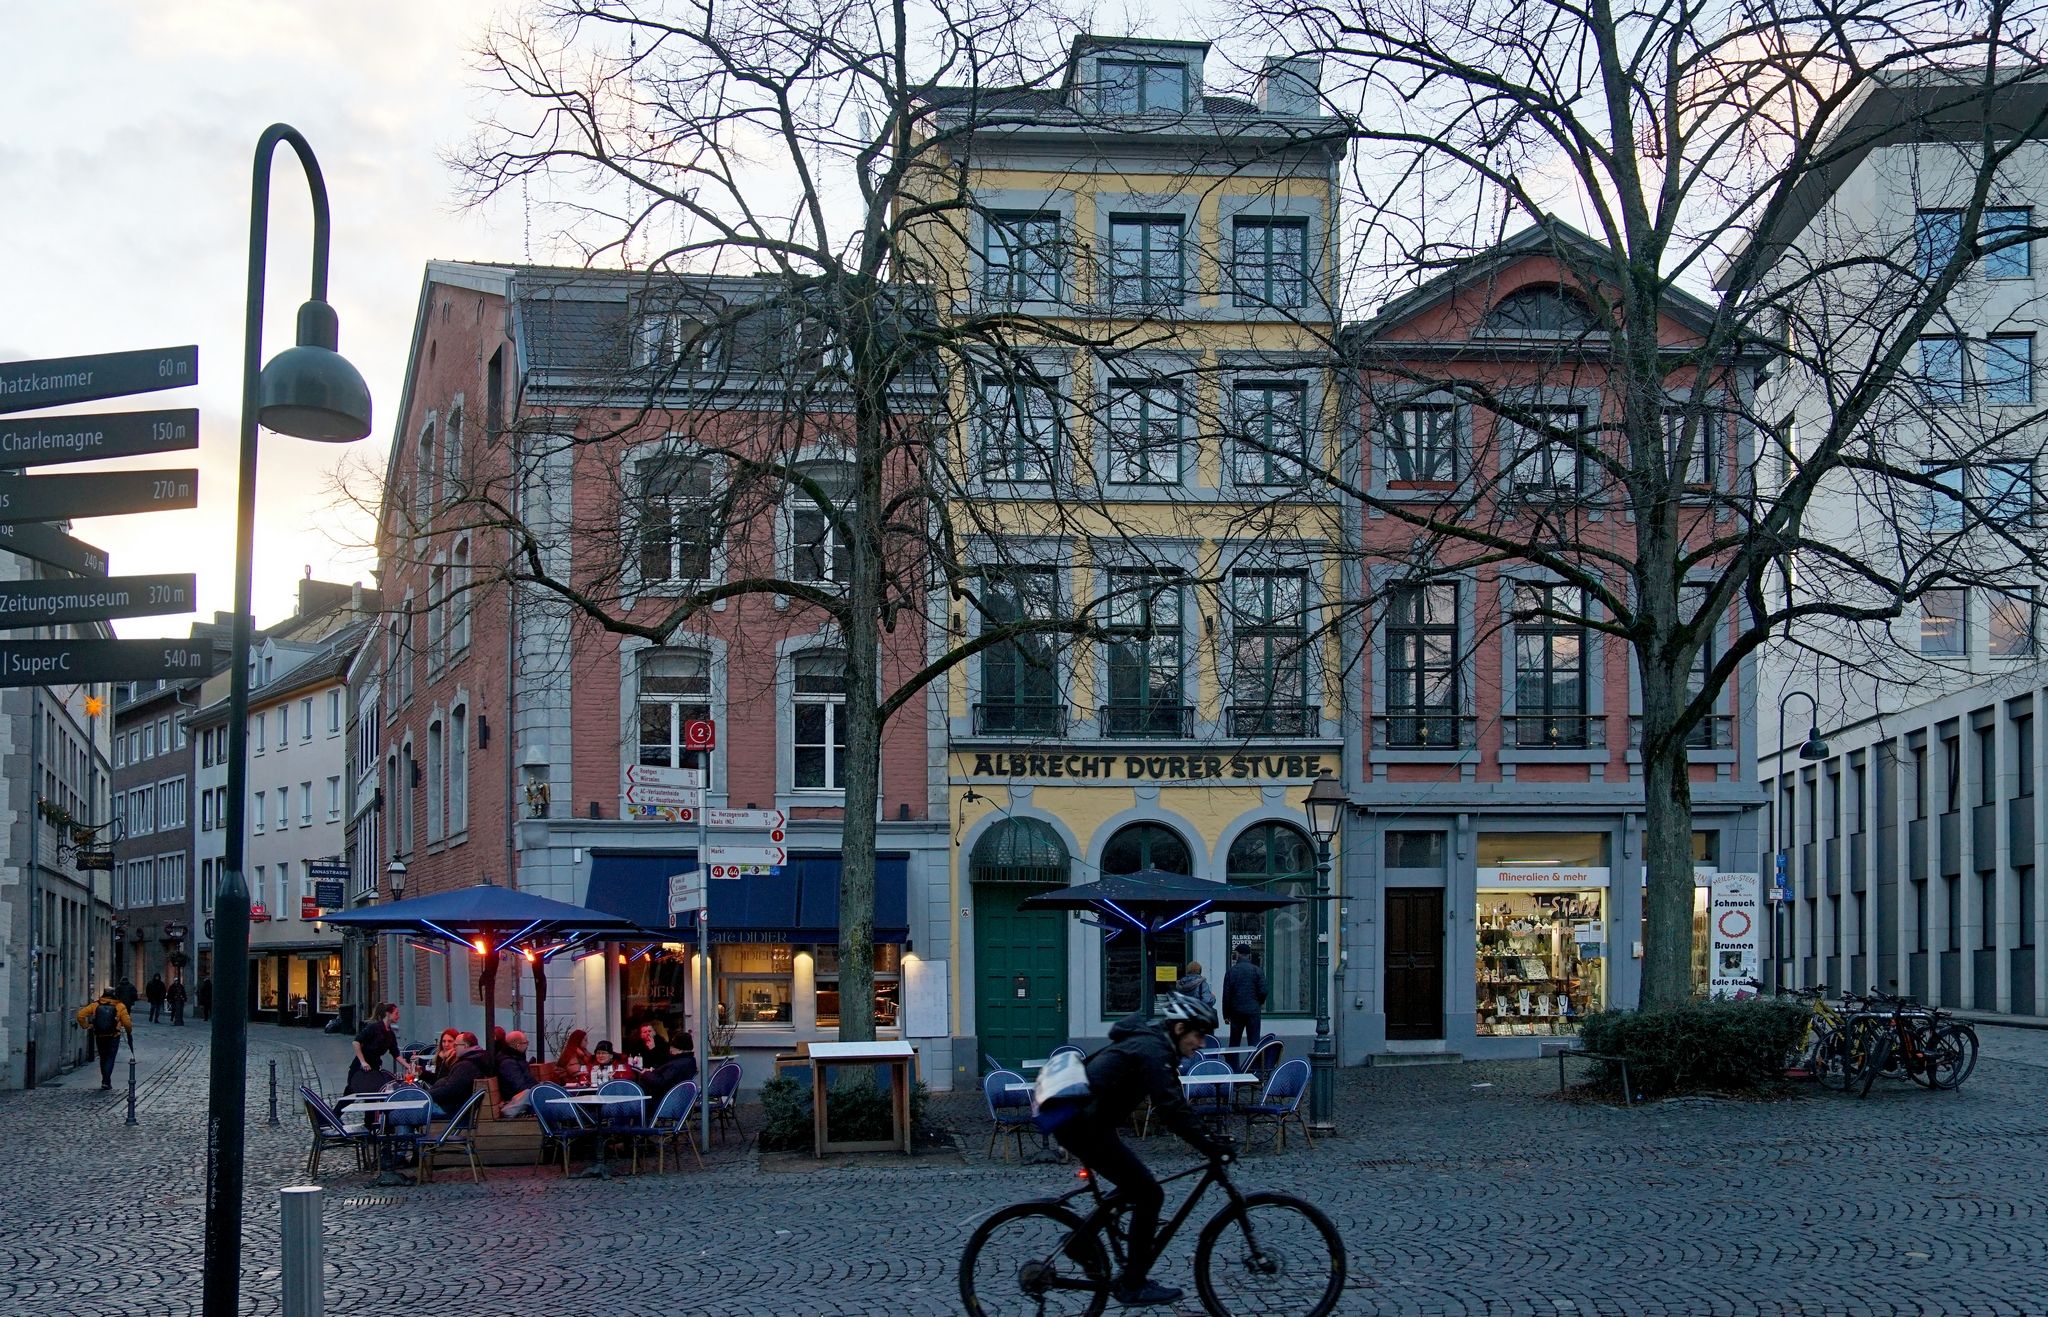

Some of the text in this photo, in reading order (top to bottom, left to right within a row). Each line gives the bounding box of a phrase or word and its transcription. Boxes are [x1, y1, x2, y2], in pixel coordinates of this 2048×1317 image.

[159, 358, 174, 377] 60
[176, 360, 188, 375] m
[2, 421, 186, 452] Charlemagne 150 m
[153, 480, 189, 499] 270 m
[84, 552, 105, 573] 240 m
[0, 585, 185, 616] Zeitungsmuseum 370 m
[11, 652, 71, 676] SuperC
[164, 649, 188, 668] 540
[190, 652, 202, 667] m
[697, 727, 705, 737] 2
[973, 753, 1322, 779] ALBRECHT DÜRER STUBE
[683, 810, 690, 819] 3
[718, 811, 749, 819] Herzogenrath
[713, 867, 722, 876] 41
[728, 867, 738, 876] 44
[1498, 872, 1588, 882] Mineralien & mehr
[1714, 899, 1756, 907] Schmuck
[739, 930, 788, 944] DIDIER
[1714, 941, 1755, 950] Brunnen
[1712, 978, 1730, 986] Edle
